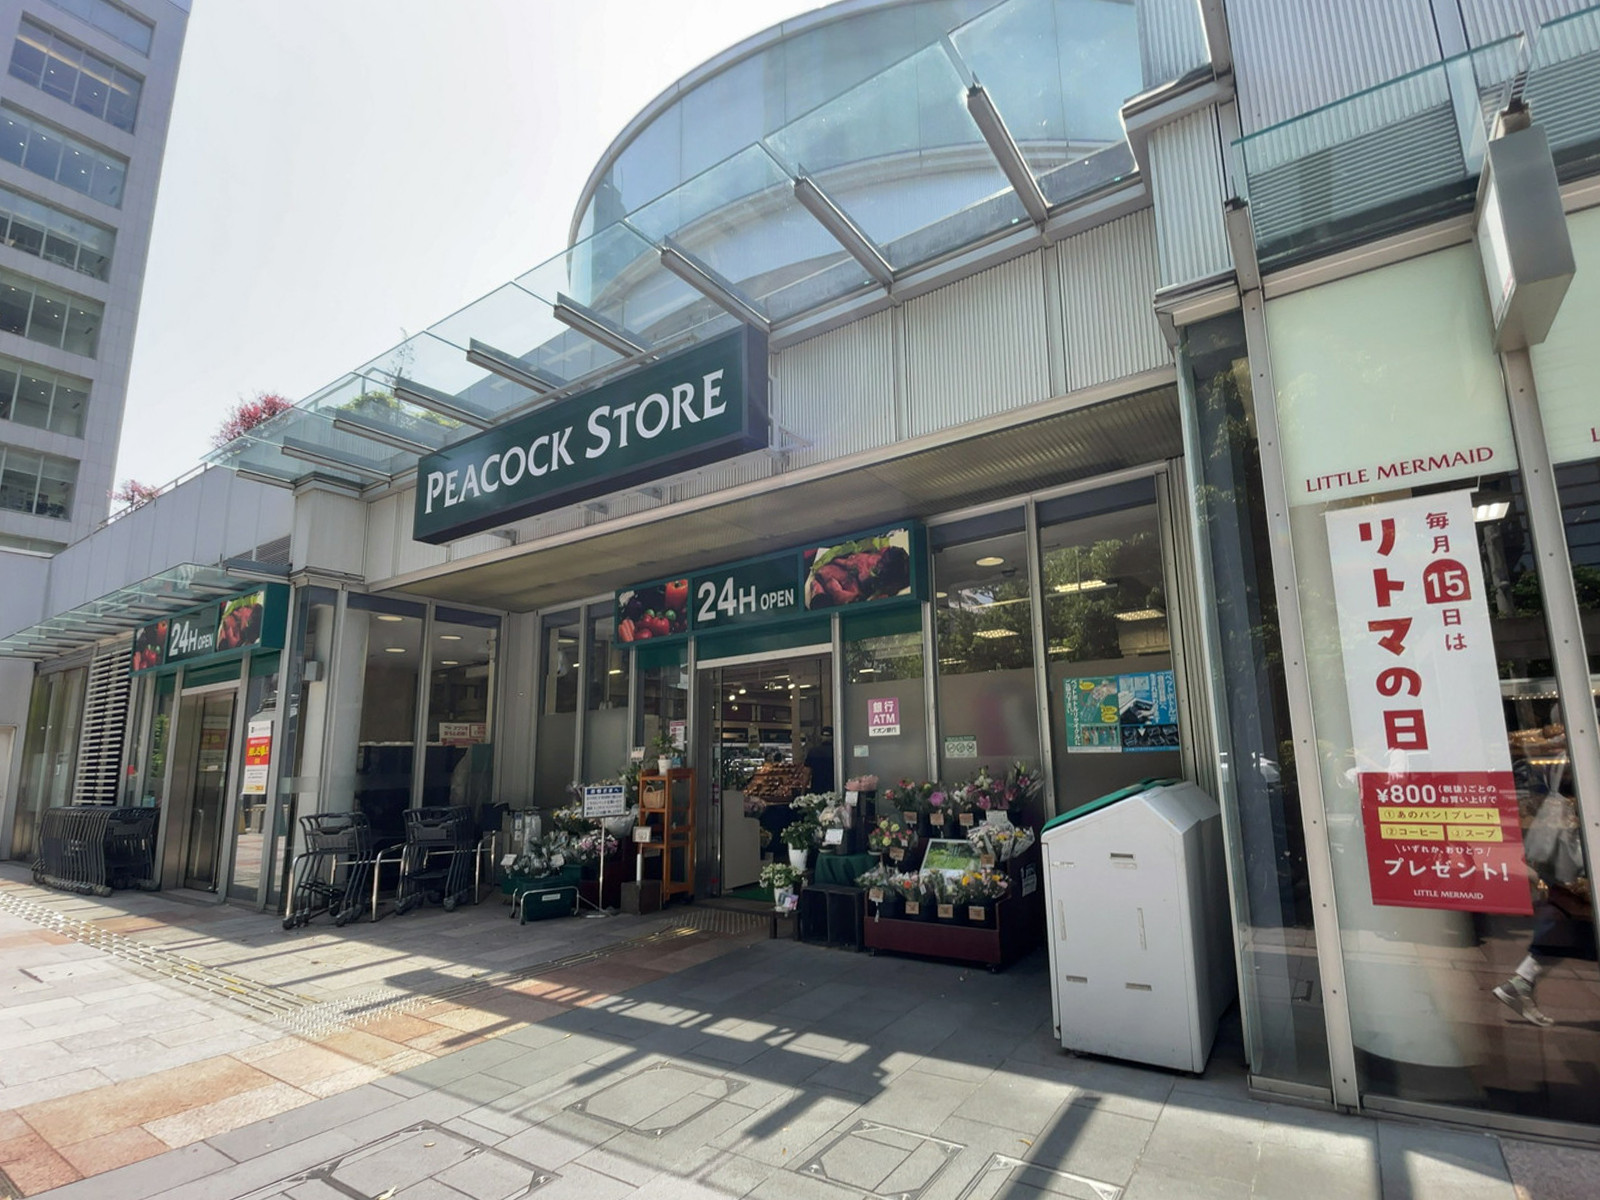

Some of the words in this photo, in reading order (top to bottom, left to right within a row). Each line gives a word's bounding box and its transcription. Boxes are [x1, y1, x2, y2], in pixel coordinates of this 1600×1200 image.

[424, 426, 575, 514] PEACOCK
[585, 368, 727, 459] STORE
[1305, 468, 1370, 493] LITTLE
[1377, 446, 1494, 481] MERMAID
[697, 576, 757, 622] 24H
[760, 588, 795, 611] OPEN
[168, 620, 199, 657] 24H
[197, 633, 214, 650] OPEN
[1358, 518, 1429, 751] リトマの日
[873, 700, 894, 713] 銀行
[873, 713, 895, 725] ATM
[1376, 784, 1437, 804] ¥800
[1440, 796, 1498, 804] お買い上げで
[1413, 888, 1439, 899] LITTLE
[1440, 890, 1485, 901] MERMAID
